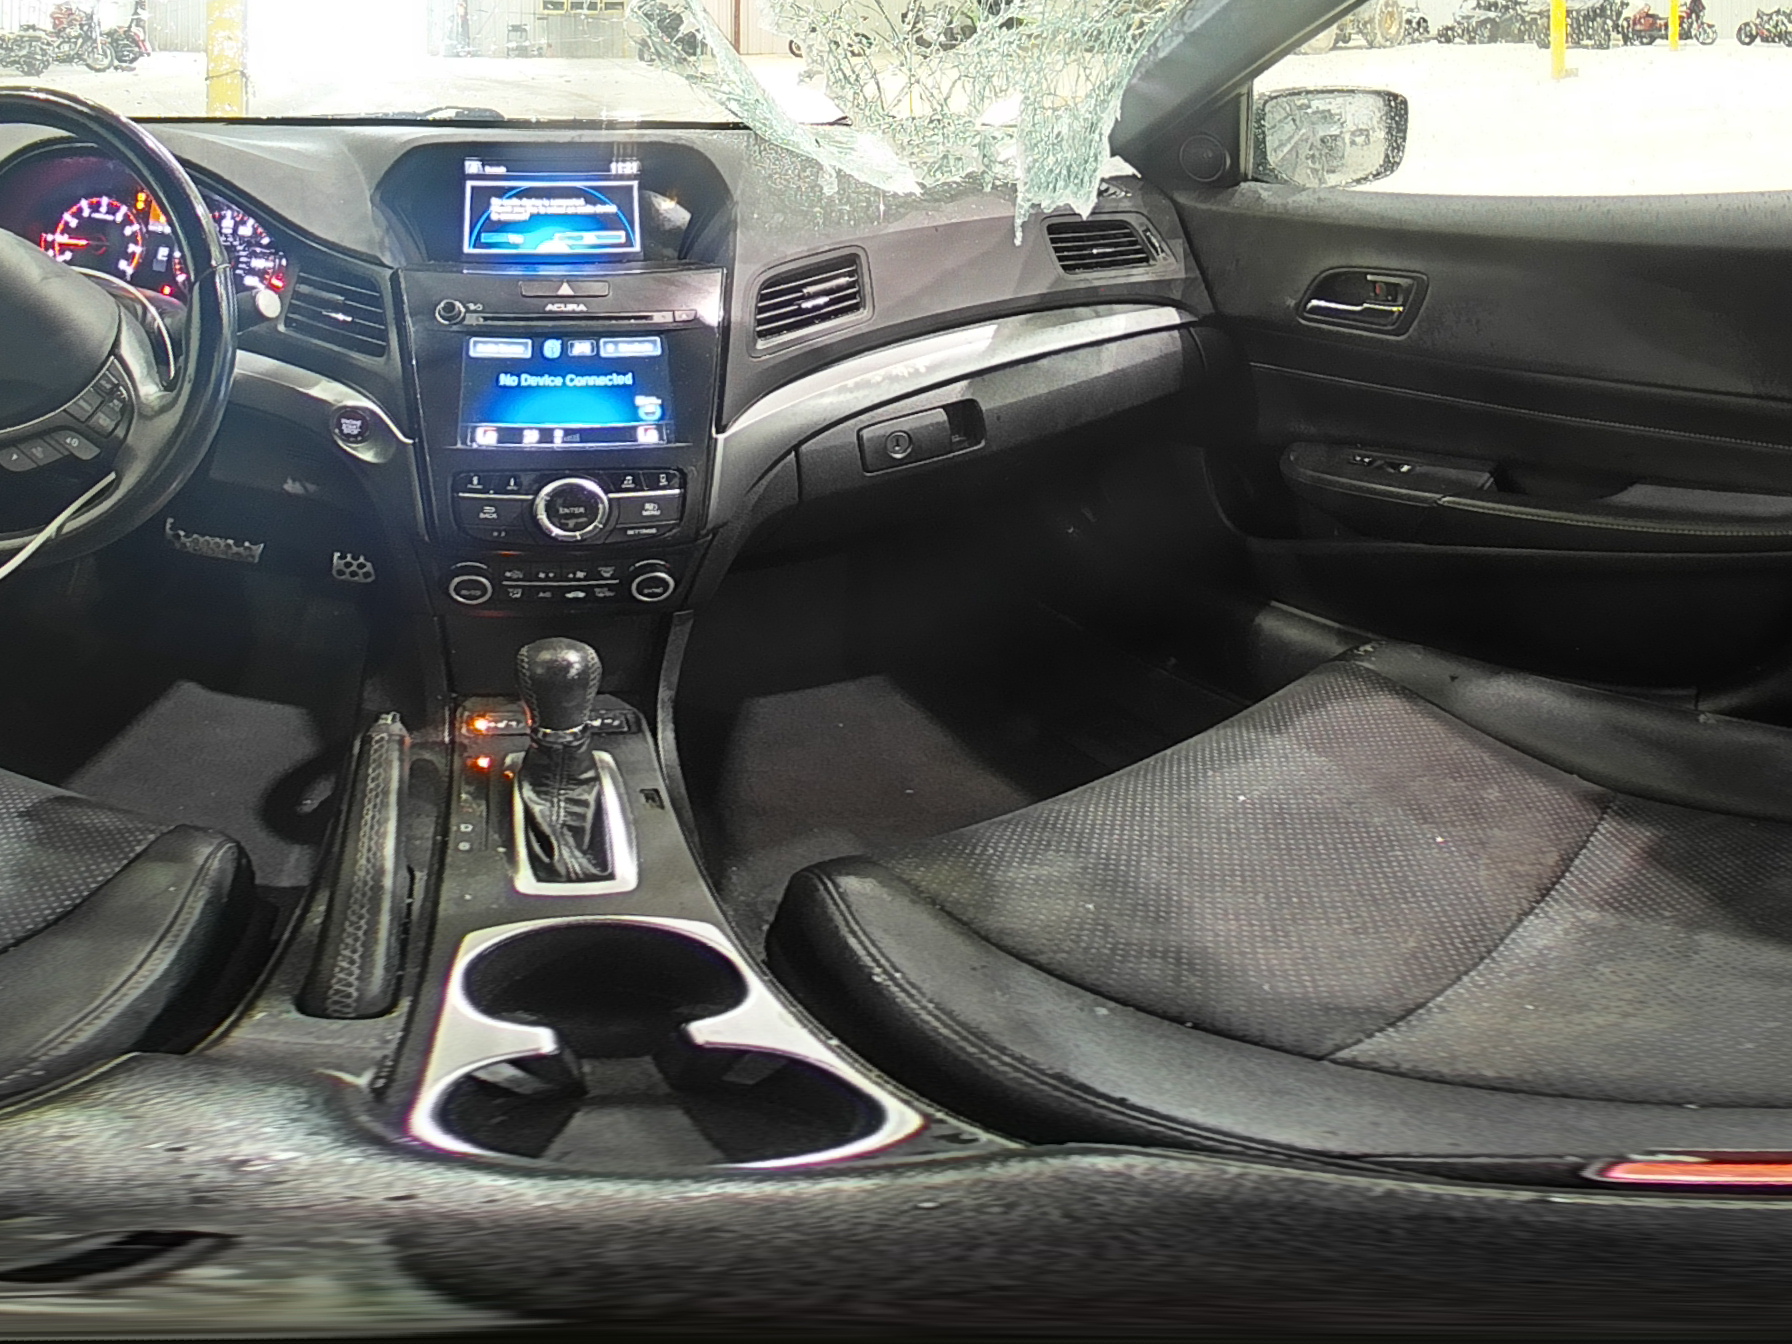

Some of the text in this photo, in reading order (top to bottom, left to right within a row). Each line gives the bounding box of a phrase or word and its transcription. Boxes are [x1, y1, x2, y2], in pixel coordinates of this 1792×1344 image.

[545, 303, 588, 312] ACURA
[498, 372, 633, 387] No Device Connected
